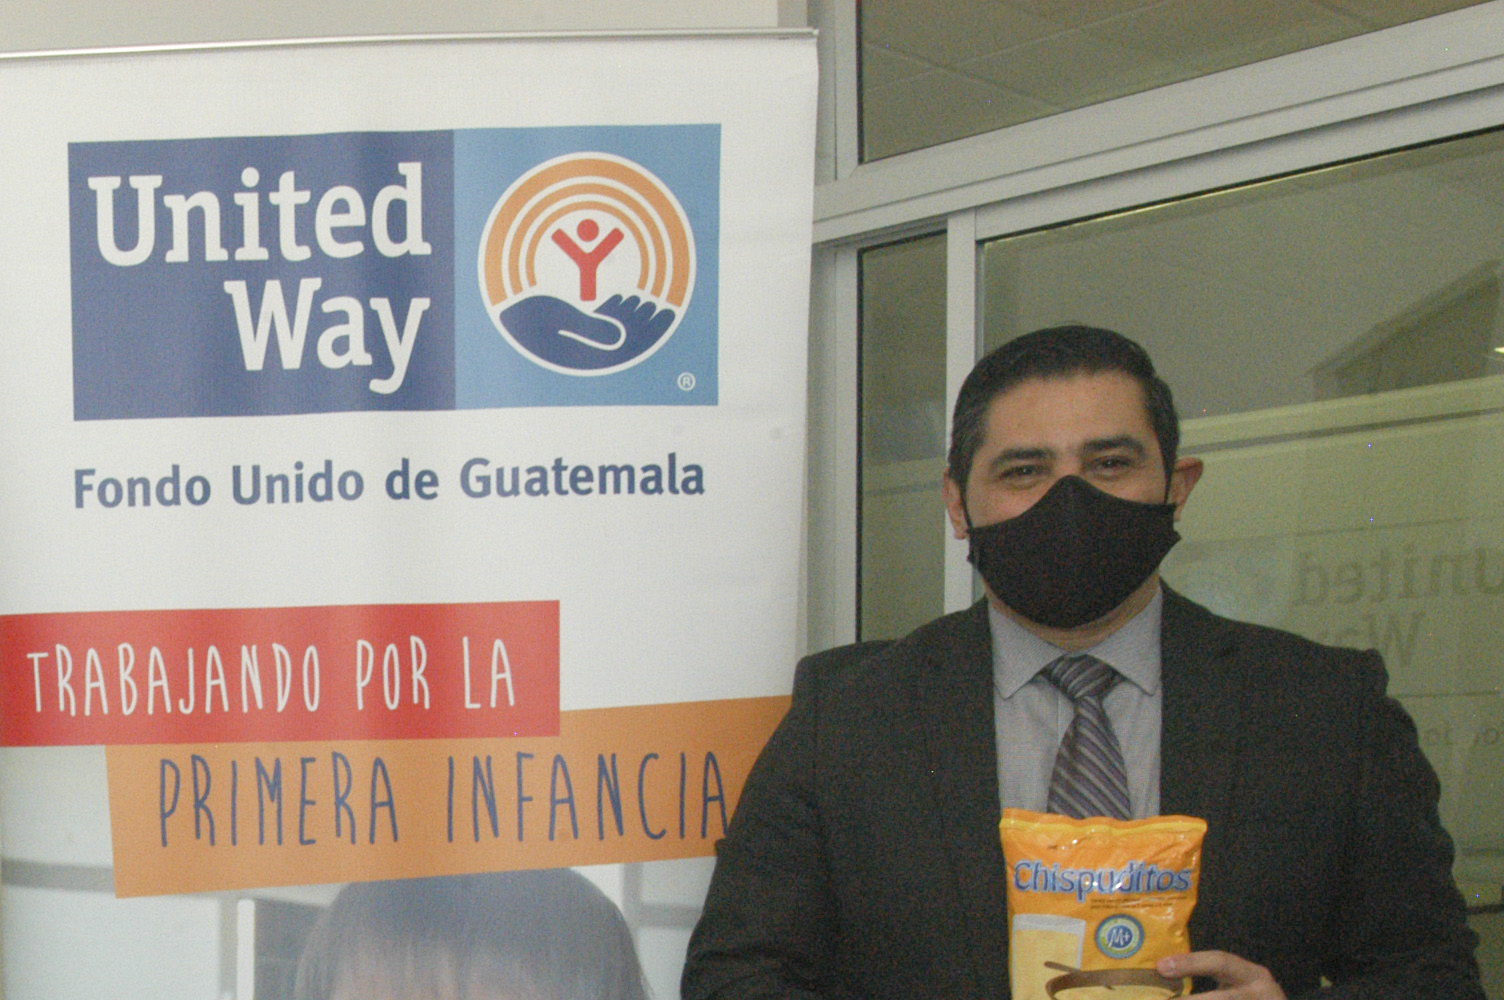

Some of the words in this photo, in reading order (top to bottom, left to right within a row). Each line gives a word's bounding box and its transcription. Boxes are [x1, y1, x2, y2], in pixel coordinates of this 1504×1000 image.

[88, 161, 432, 267] United
[223, 276, 431, 395] Way
[73, 463, 212, 509] Fondo
[231, 459, 365, 505] Unido
[384, 457, 441, 502] de
[459, 452, 706, 500] Guatemala
[26, 641, 321, 718] TRABAJANDO
[355, 634, 432, 712] POR
[462, 635, 516, 710] LA
[158, 751, 399, 848] PRIMERA
[446, 749, 730, 843] INFANCIA
[1014, 861, 1191, 902] Chispuditos
